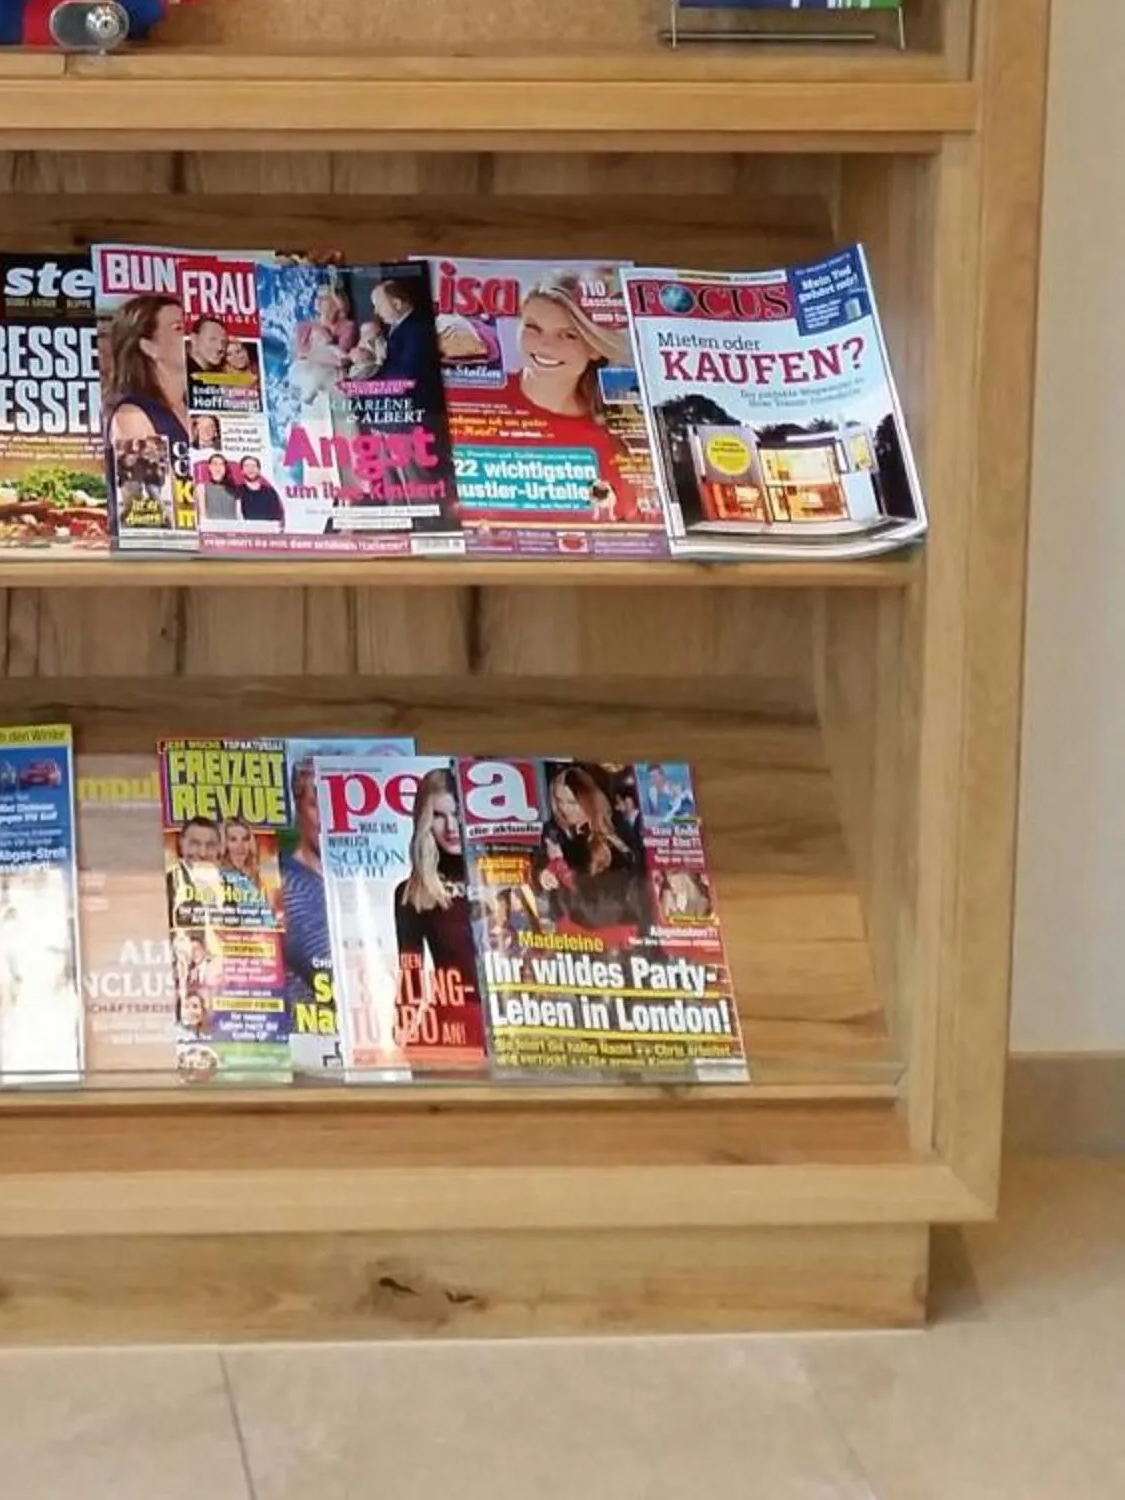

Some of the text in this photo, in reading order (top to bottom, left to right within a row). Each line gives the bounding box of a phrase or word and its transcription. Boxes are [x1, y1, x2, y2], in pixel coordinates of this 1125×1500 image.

[106, 251, 177, 294] BUN
[436, 260, 521, 317] isa
[181, 269, 257, 316] FRAU
[630, 281, 793, 319] FOCUS
[656, 331, 762, 351] Mieten oder
[659, 336, 866, 385] KAUFEN?
[361, 409, 426, 424] ALBERT
[282, 421, 440, 482] Angst
[454, 459, 598, 483] 22 wichtigsten
[284, 484, 318, 499] um
[168, 750, 285, 786] FREIZEIT
[171, 784, 288, 824] REVUE
[466, 761, 539, 821] a
[328, 844, 407, 865] SCHÖN
[518, 930, 604, 953] Madeleine
[484, 952, 718, 998] Ihr wildes Party-
[442, 1021, 467, 1045] AN!
[489, 993, 733, 1034] Leben in London!
